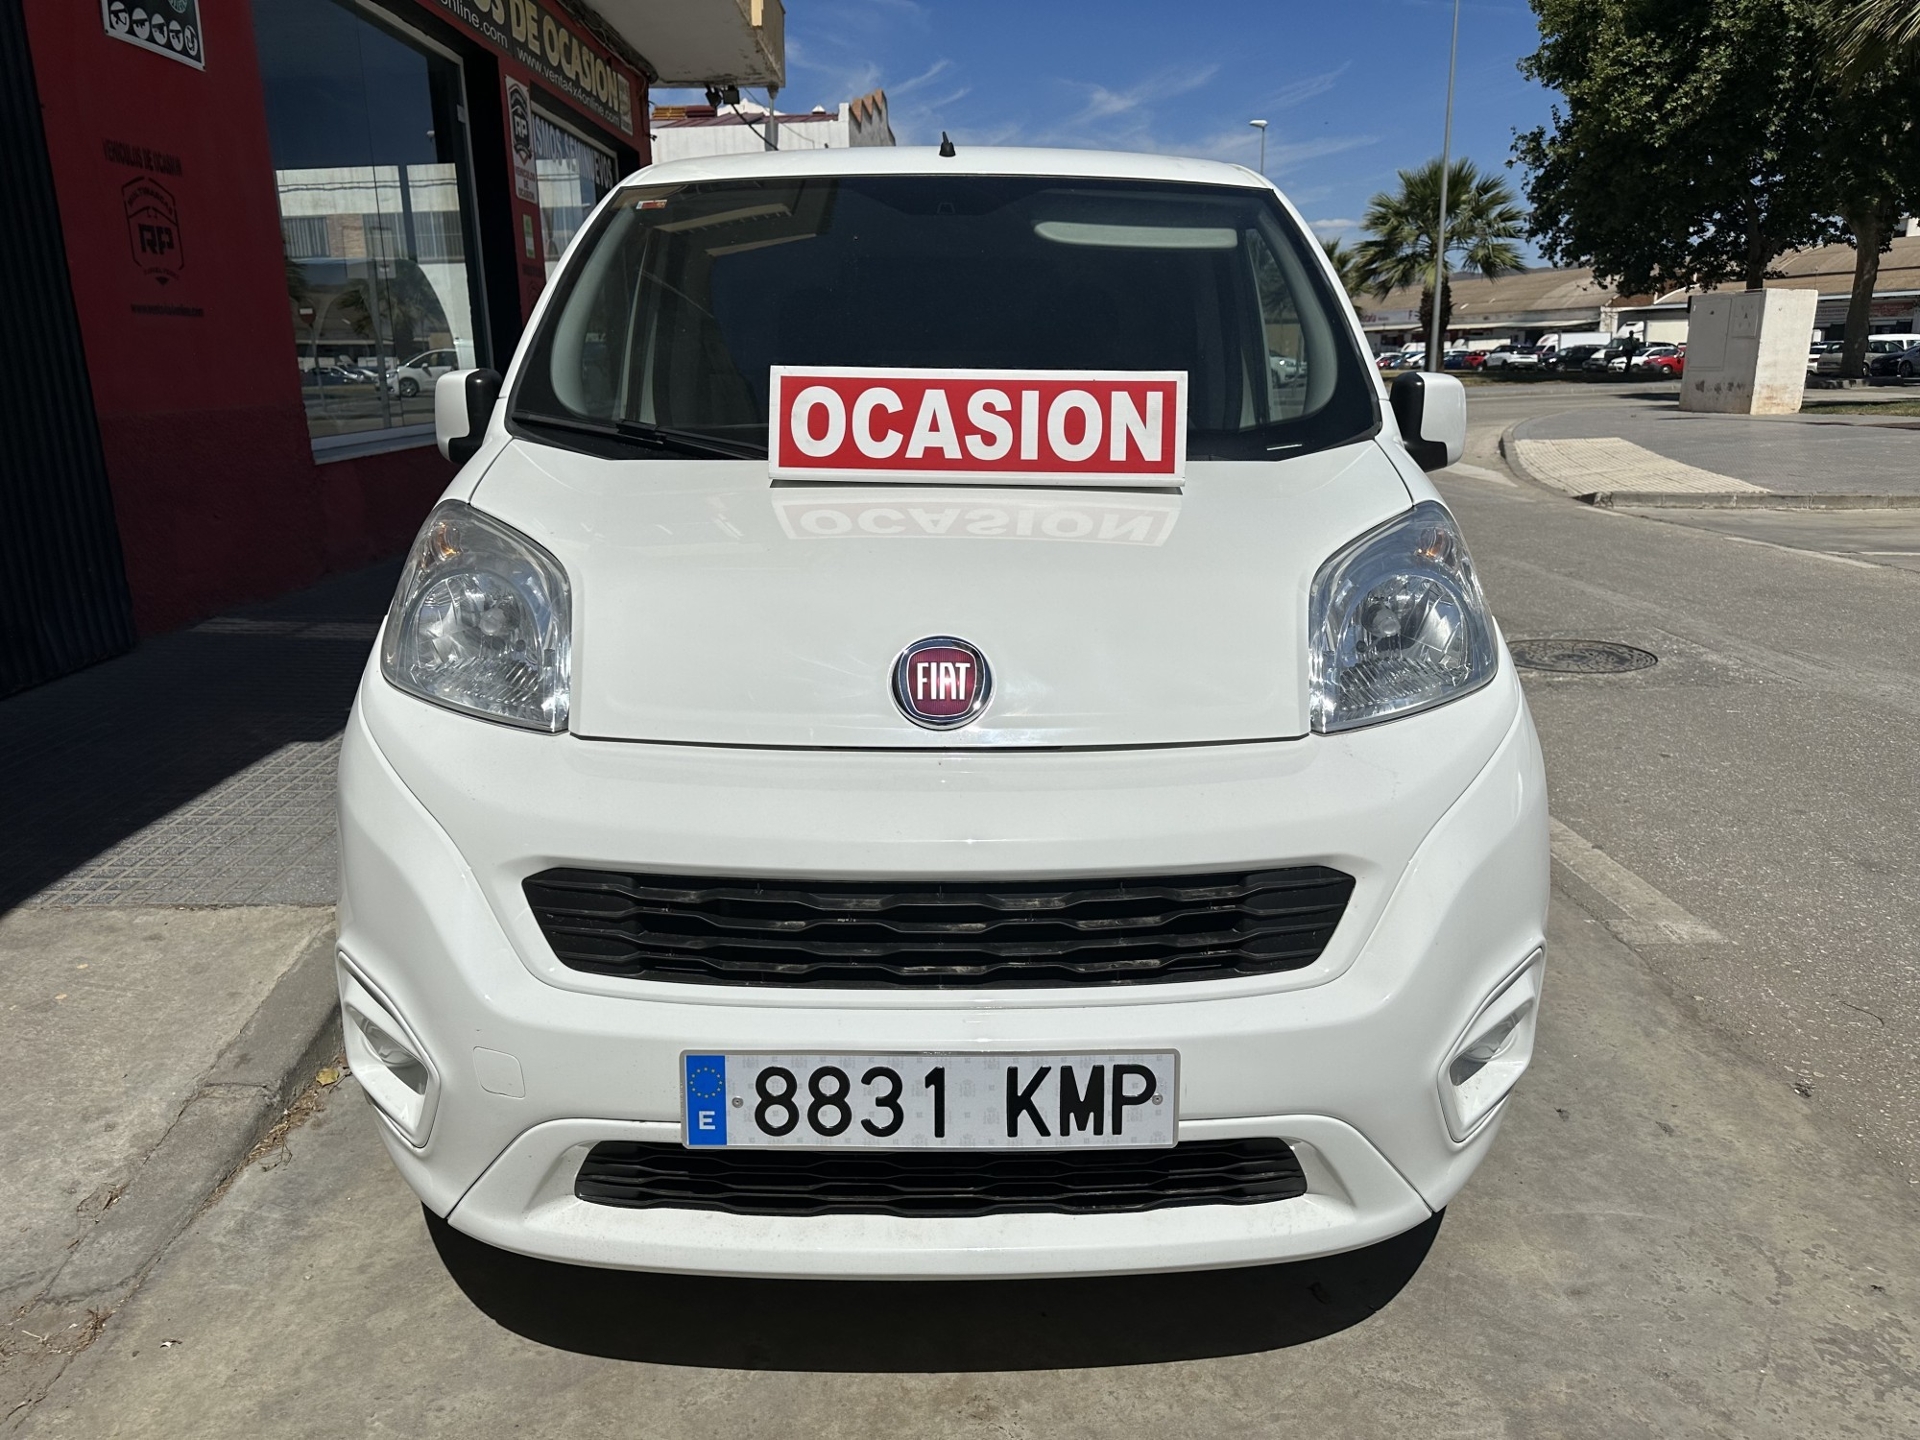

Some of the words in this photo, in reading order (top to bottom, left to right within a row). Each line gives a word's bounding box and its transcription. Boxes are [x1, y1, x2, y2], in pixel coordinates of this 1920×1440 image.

[441, 0, 508, 49] nline.com
[509, 0, 541, 56] DE
[542, 15, 619, 111] OCASION
[516, 47, 620, 126] www.venta4x4online.com
[514, 116, 528, 138] RP
[138, 223, 174, 255] RP
[790, 385, 1164, 462] OCASION
[916, 661, 971, 701] FIAT
[698, 1110, 715, 1130] E
[754, 1064, 945, 1138] 8831
[1006, 1063, 1157, 1138] KMP
